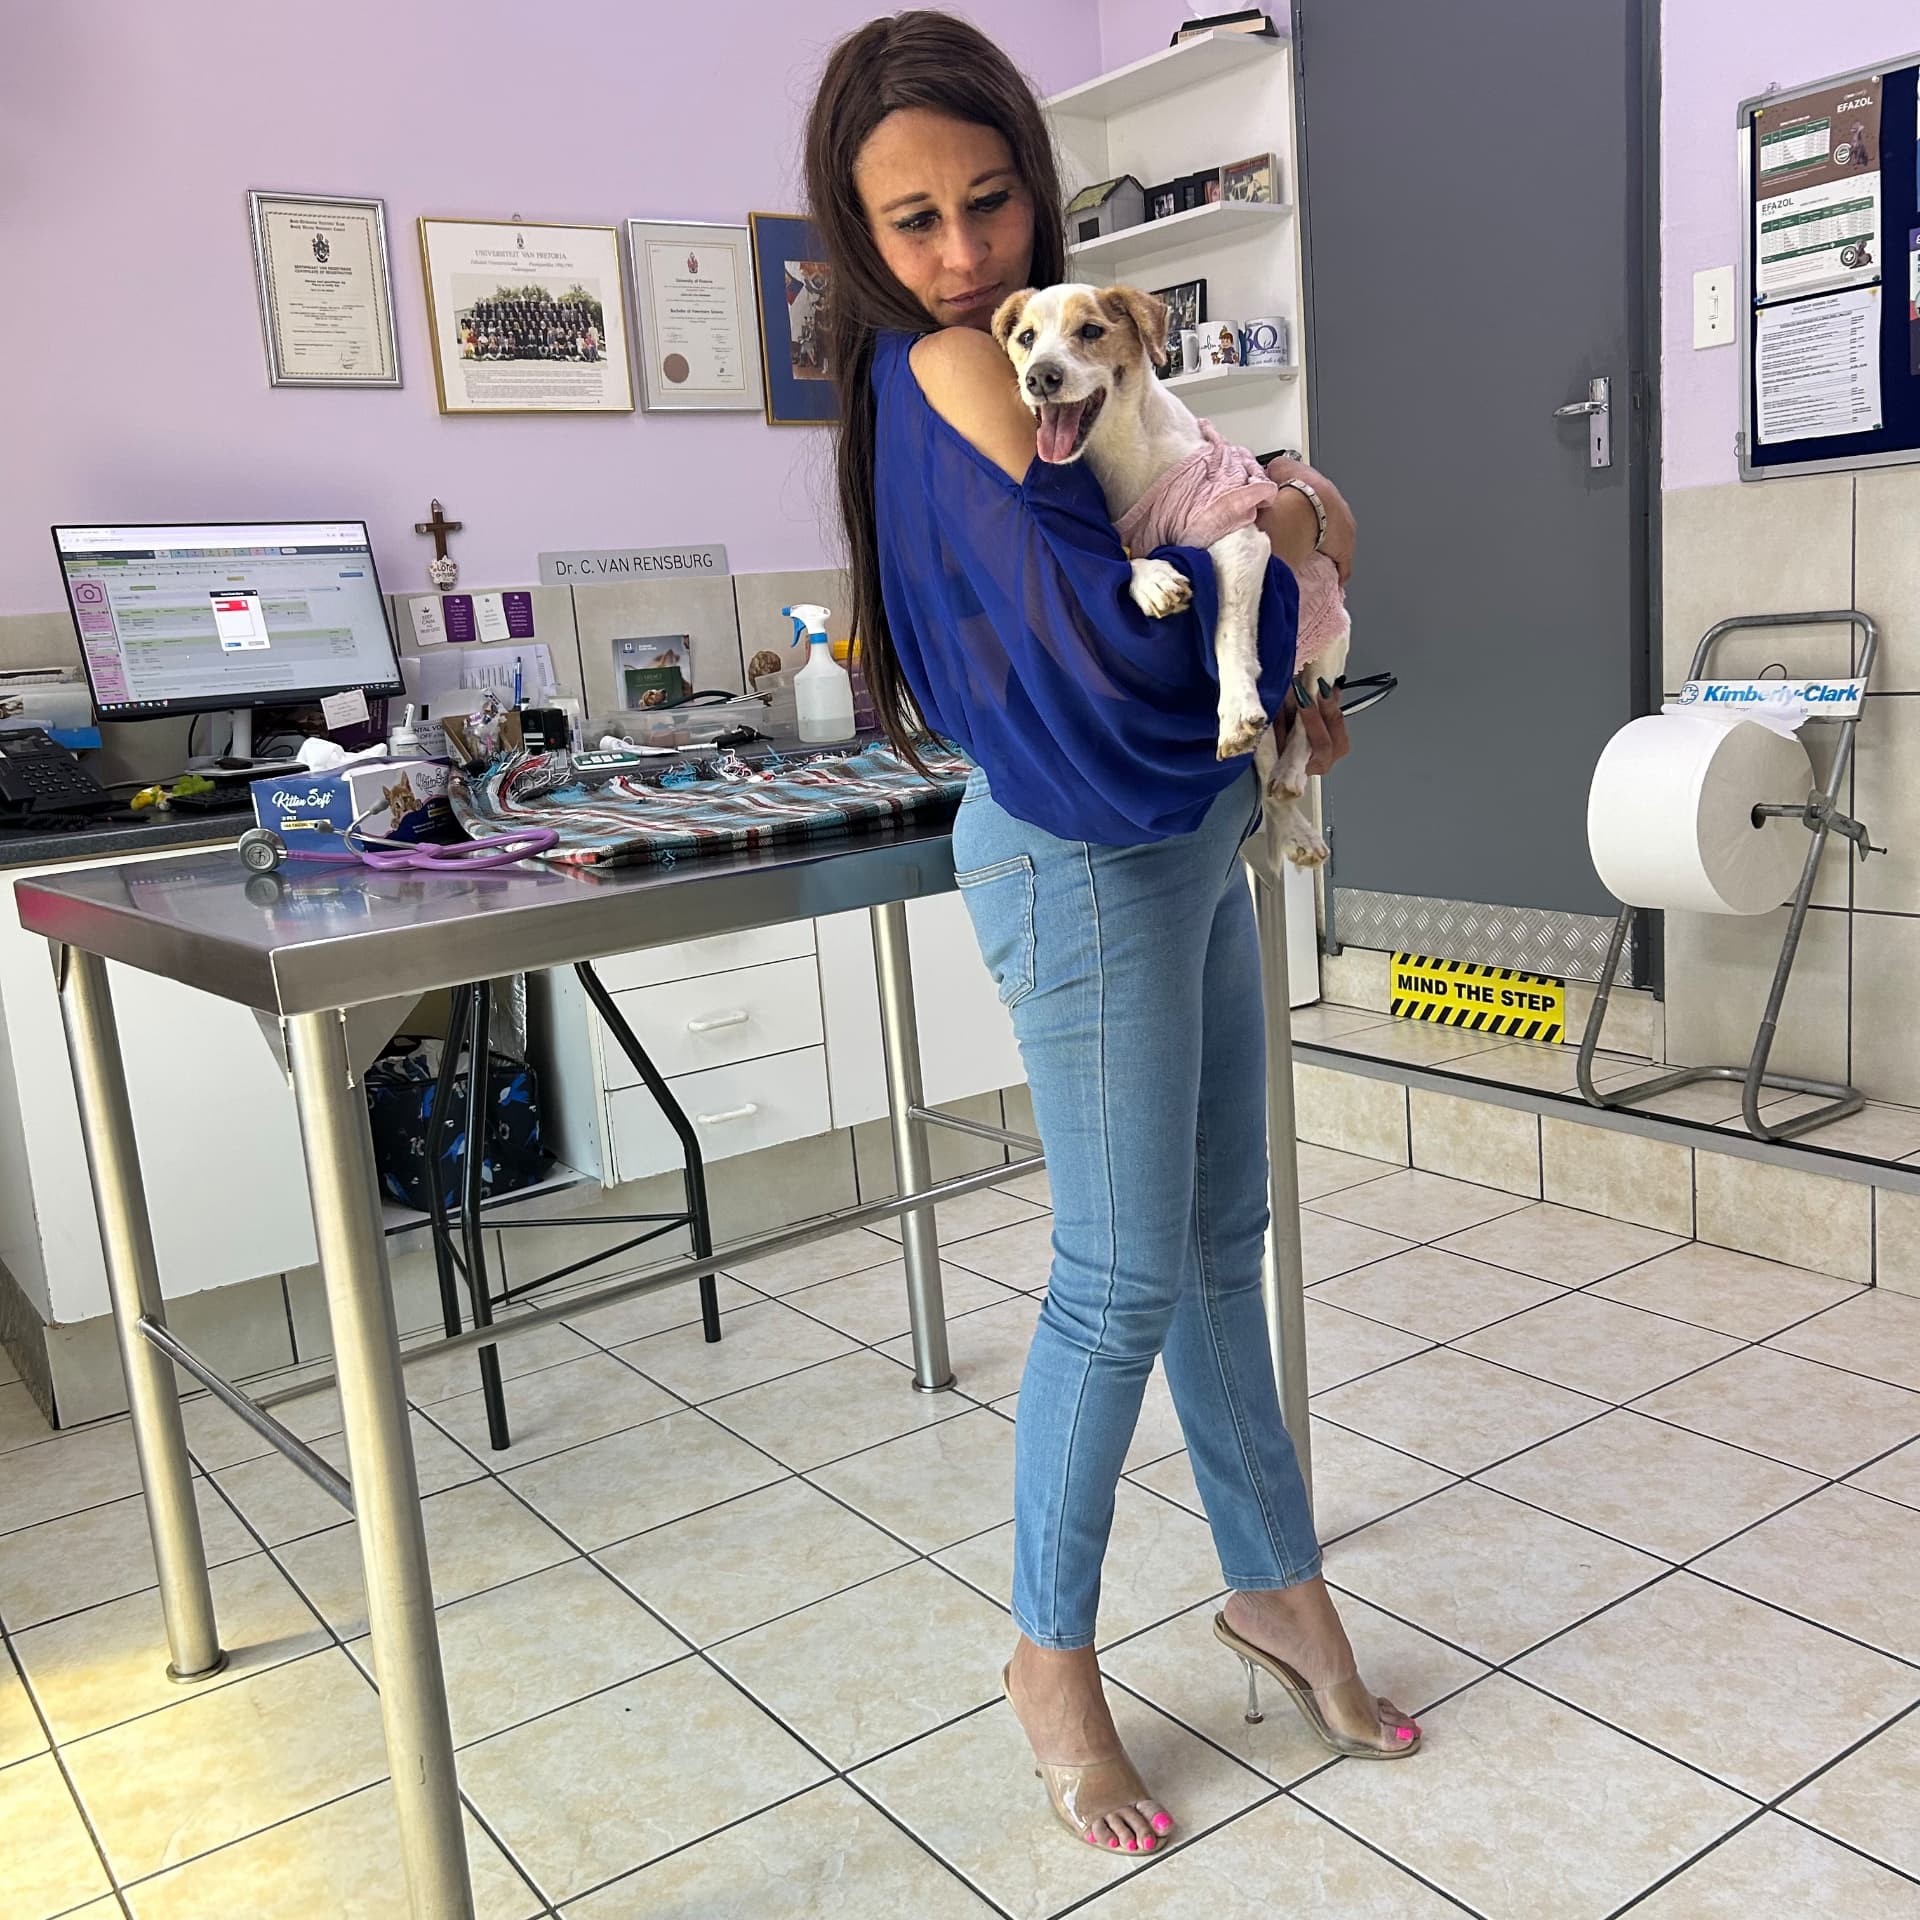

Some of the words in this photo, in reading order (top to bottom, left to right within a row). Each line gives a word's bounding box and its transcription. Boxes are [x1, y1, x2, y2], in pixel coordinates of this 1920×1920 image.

[1837, 97, 1873, 113] EFAZOL
[1762, 198, 1794, 212] EFAZOL
[475, 249, 519, 258] UNIVERSITEIT
[536, 252, 567, 260] PRETORIA
[555, 560, 577, 576] Dr.
[580, 559, 595, 575] C.
[597, 557, 630, 573] VAN
[633, 553, 713, 572] RENSBURG
[272, 790, 307, 814] Kitten
[307, 788, 334, 809] Soft
[1397, 974, 1448, 996] MIND
[1453, 982, 1494, 1004] THE
[1500, 989, 1556, 1012] STEP
